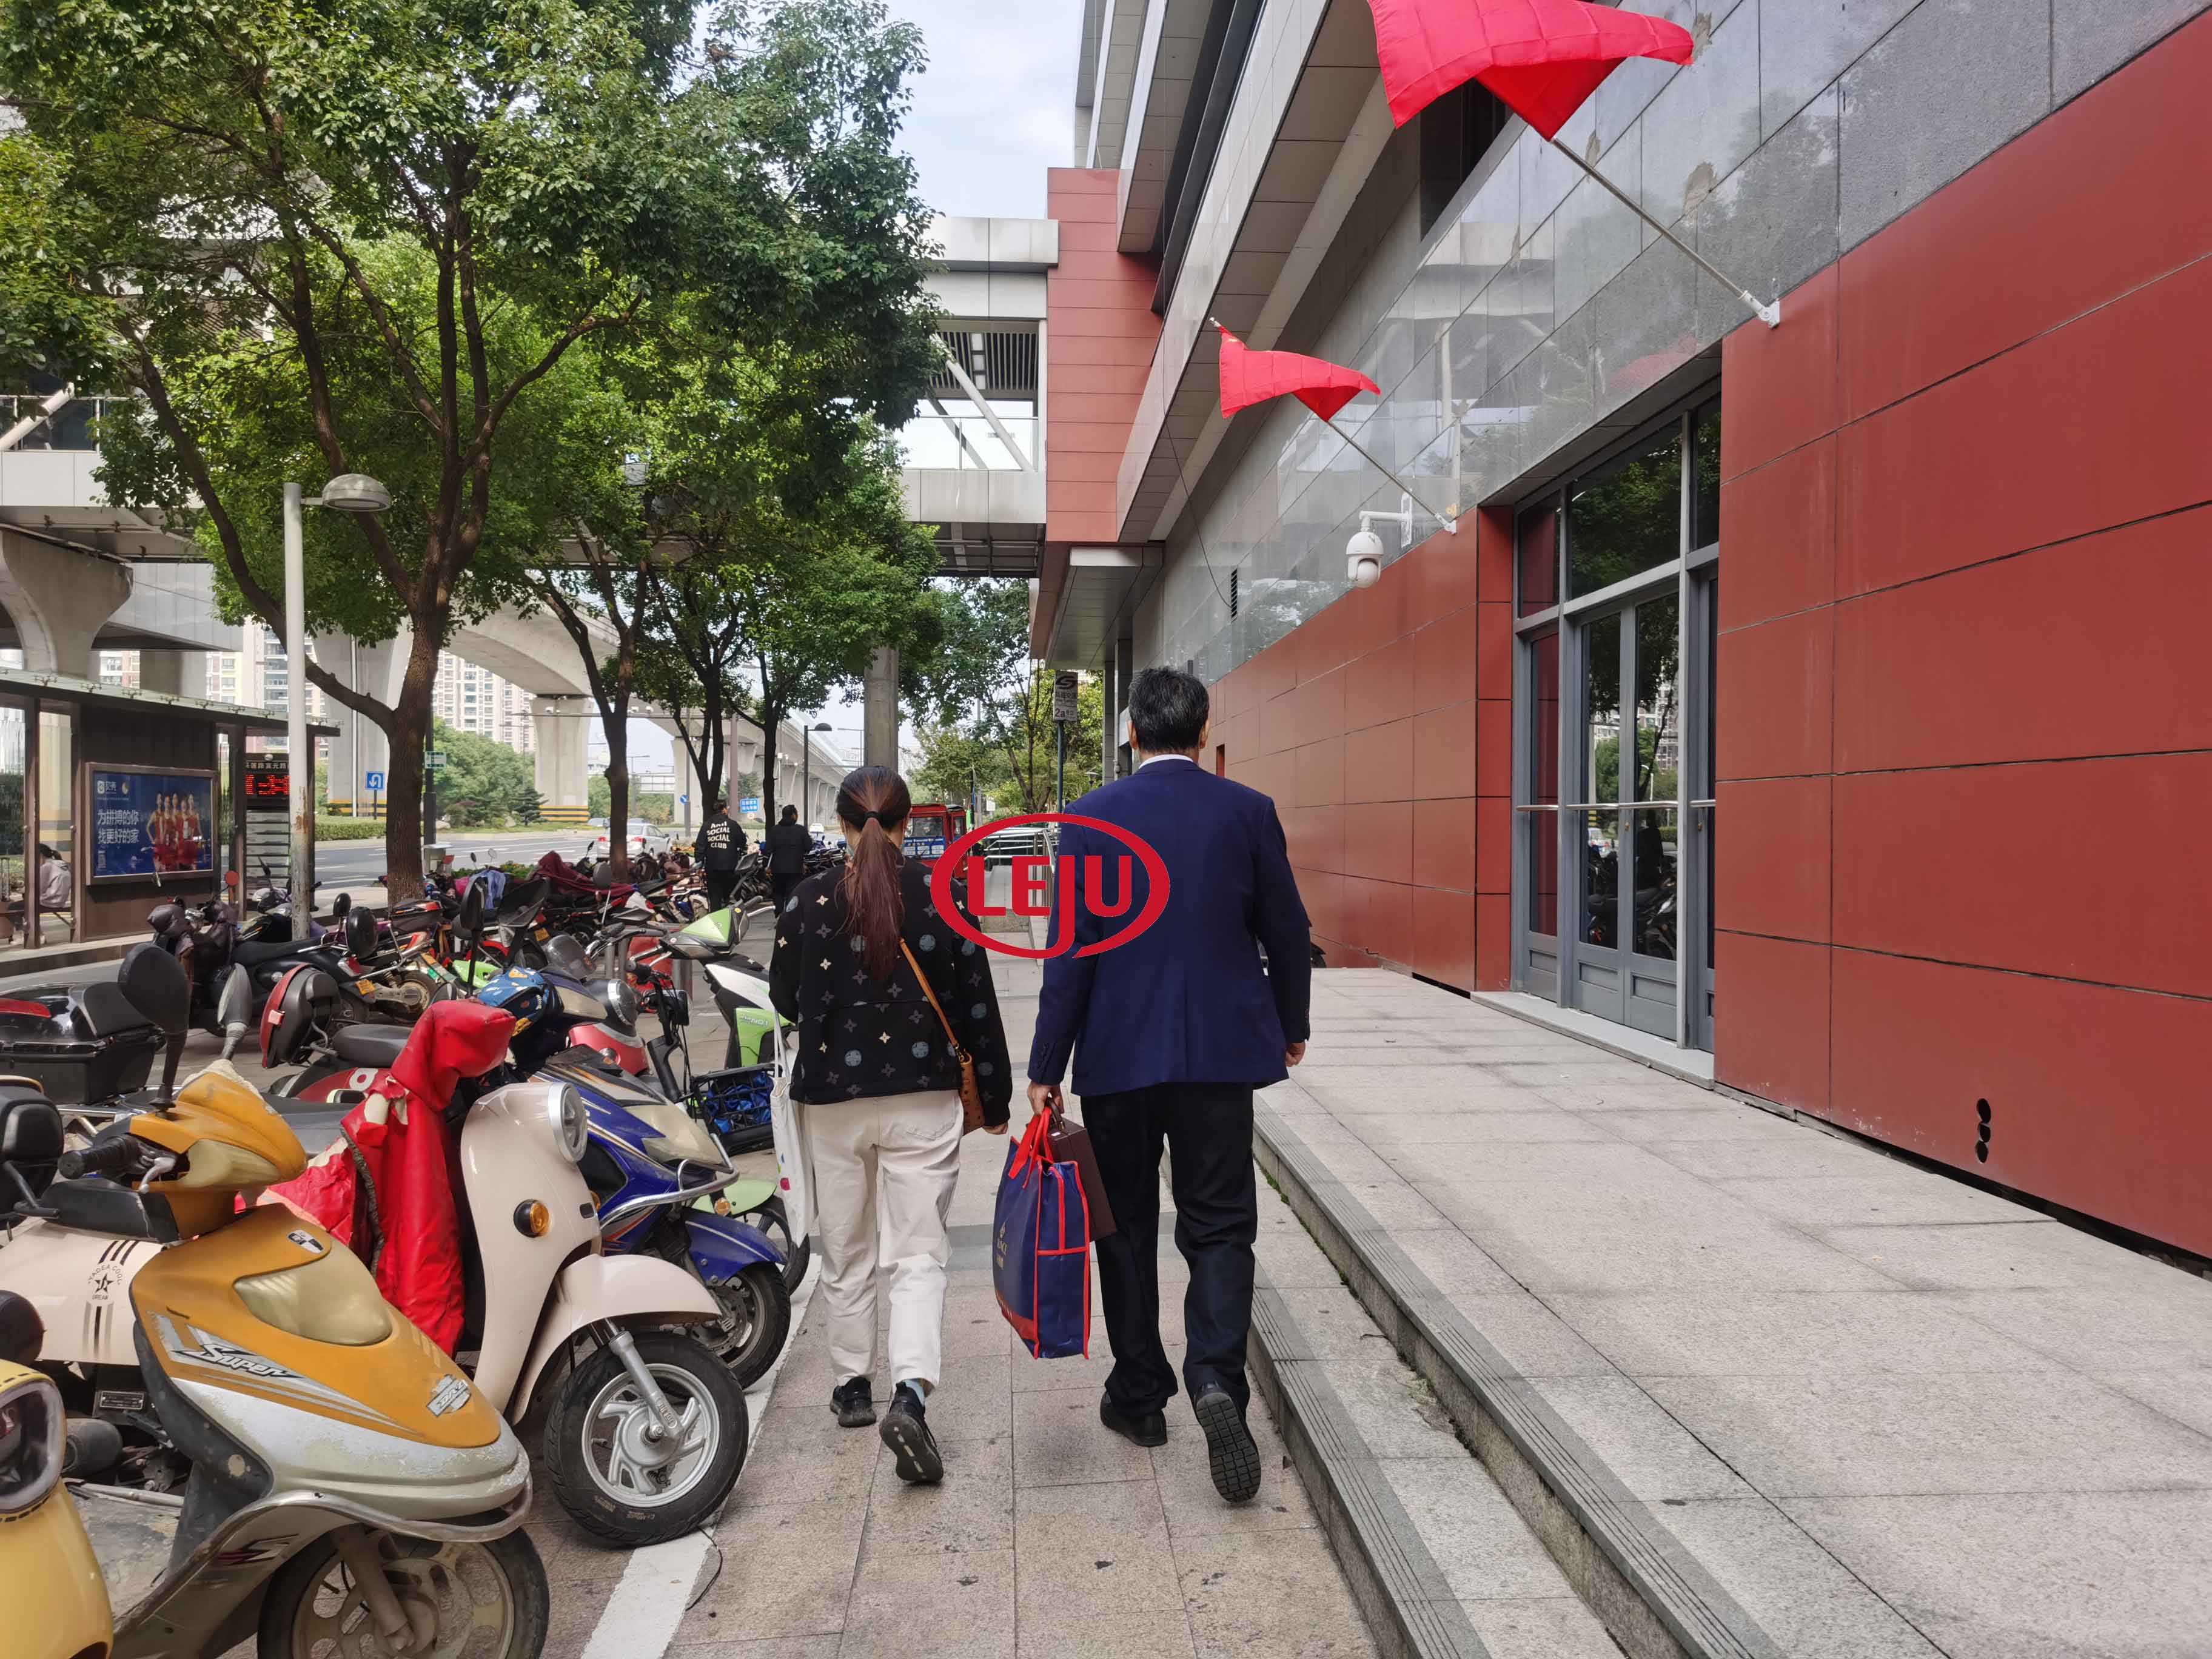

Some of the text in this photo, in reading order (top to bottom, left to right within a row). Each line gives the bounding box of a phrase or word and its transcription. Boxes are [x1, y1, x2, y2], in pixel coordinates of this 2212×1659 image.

[1055, 708, 1065, 717] 2a
[98, 809, 139, 825] 为拼搏的你
[98, 828, 139, 845] 找更好的家
[706, 827, 730, 836] SOCIAL
